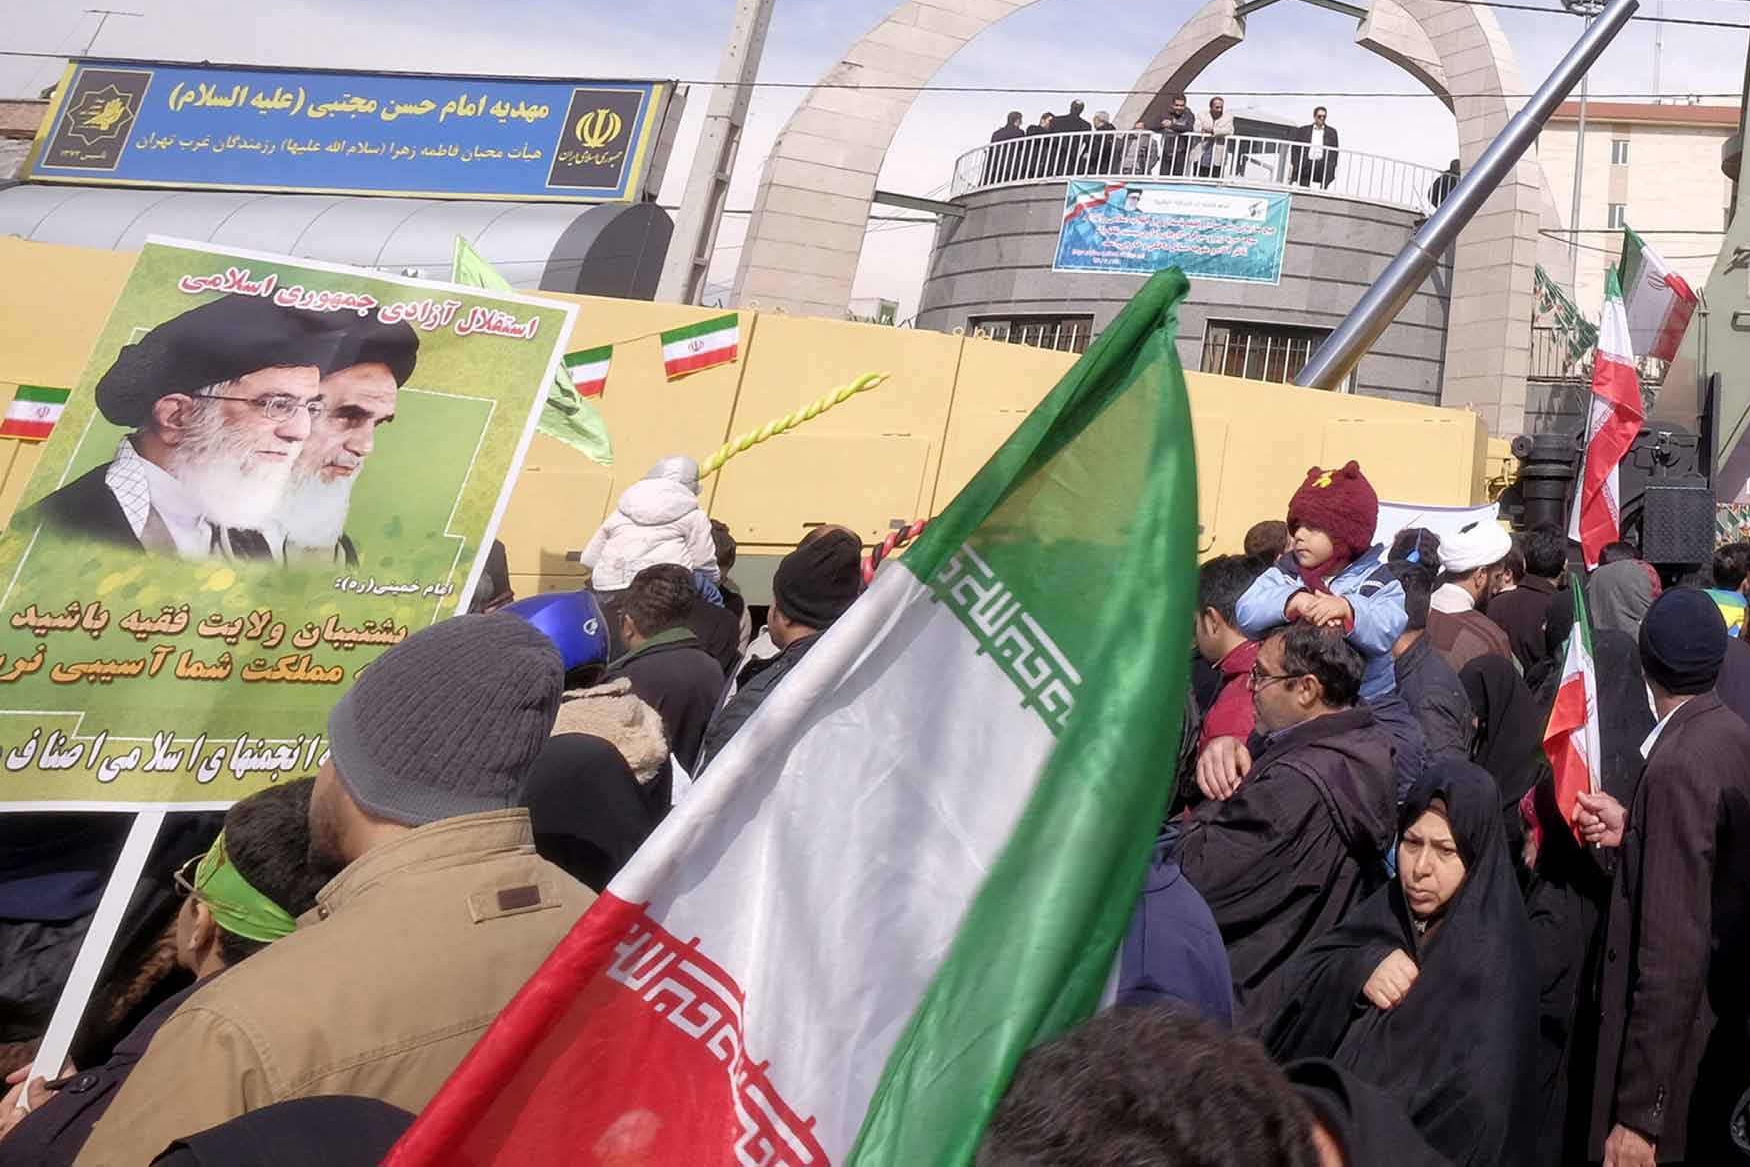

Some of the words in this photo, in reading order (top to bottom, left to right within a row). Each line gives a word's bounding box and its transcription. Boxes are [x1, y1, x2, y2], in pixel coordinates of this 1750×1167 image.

[307, 93, 377, 118] مجتبی
[380, 97, 437, 121] حسن
[439, 94, 488, 123] امام
[489, 100, 549, 123] مهدیه
[135, 132, 176, 150] تهران
[178, 135, 210, 151] غرب
[212, 134, 276, 154] رزمندگان
[325, 139, 345, 153] الله
[391, 143, 417, 160] زهرا
[421, 143, 459, 158] فاطمه
[460, 144, 503, 162] محبان
[178, 267, 278, 297] اسلامی
[274, 286, 377, 317] جمهوری
[378, 300, 459, 332] آزادی
[456, 307, 540, 340] استقلال
[422, 582, 454, 598] امام
[10, 601, 110, 638] باشید
[119, 605, 190, 635] فقیه
[198, 612, 284, 648] ولایت
[51, 644, 176, 683] آسیبی
[175, 650, 232, 681] شما
[240, 653, 345, 686] مملکت
